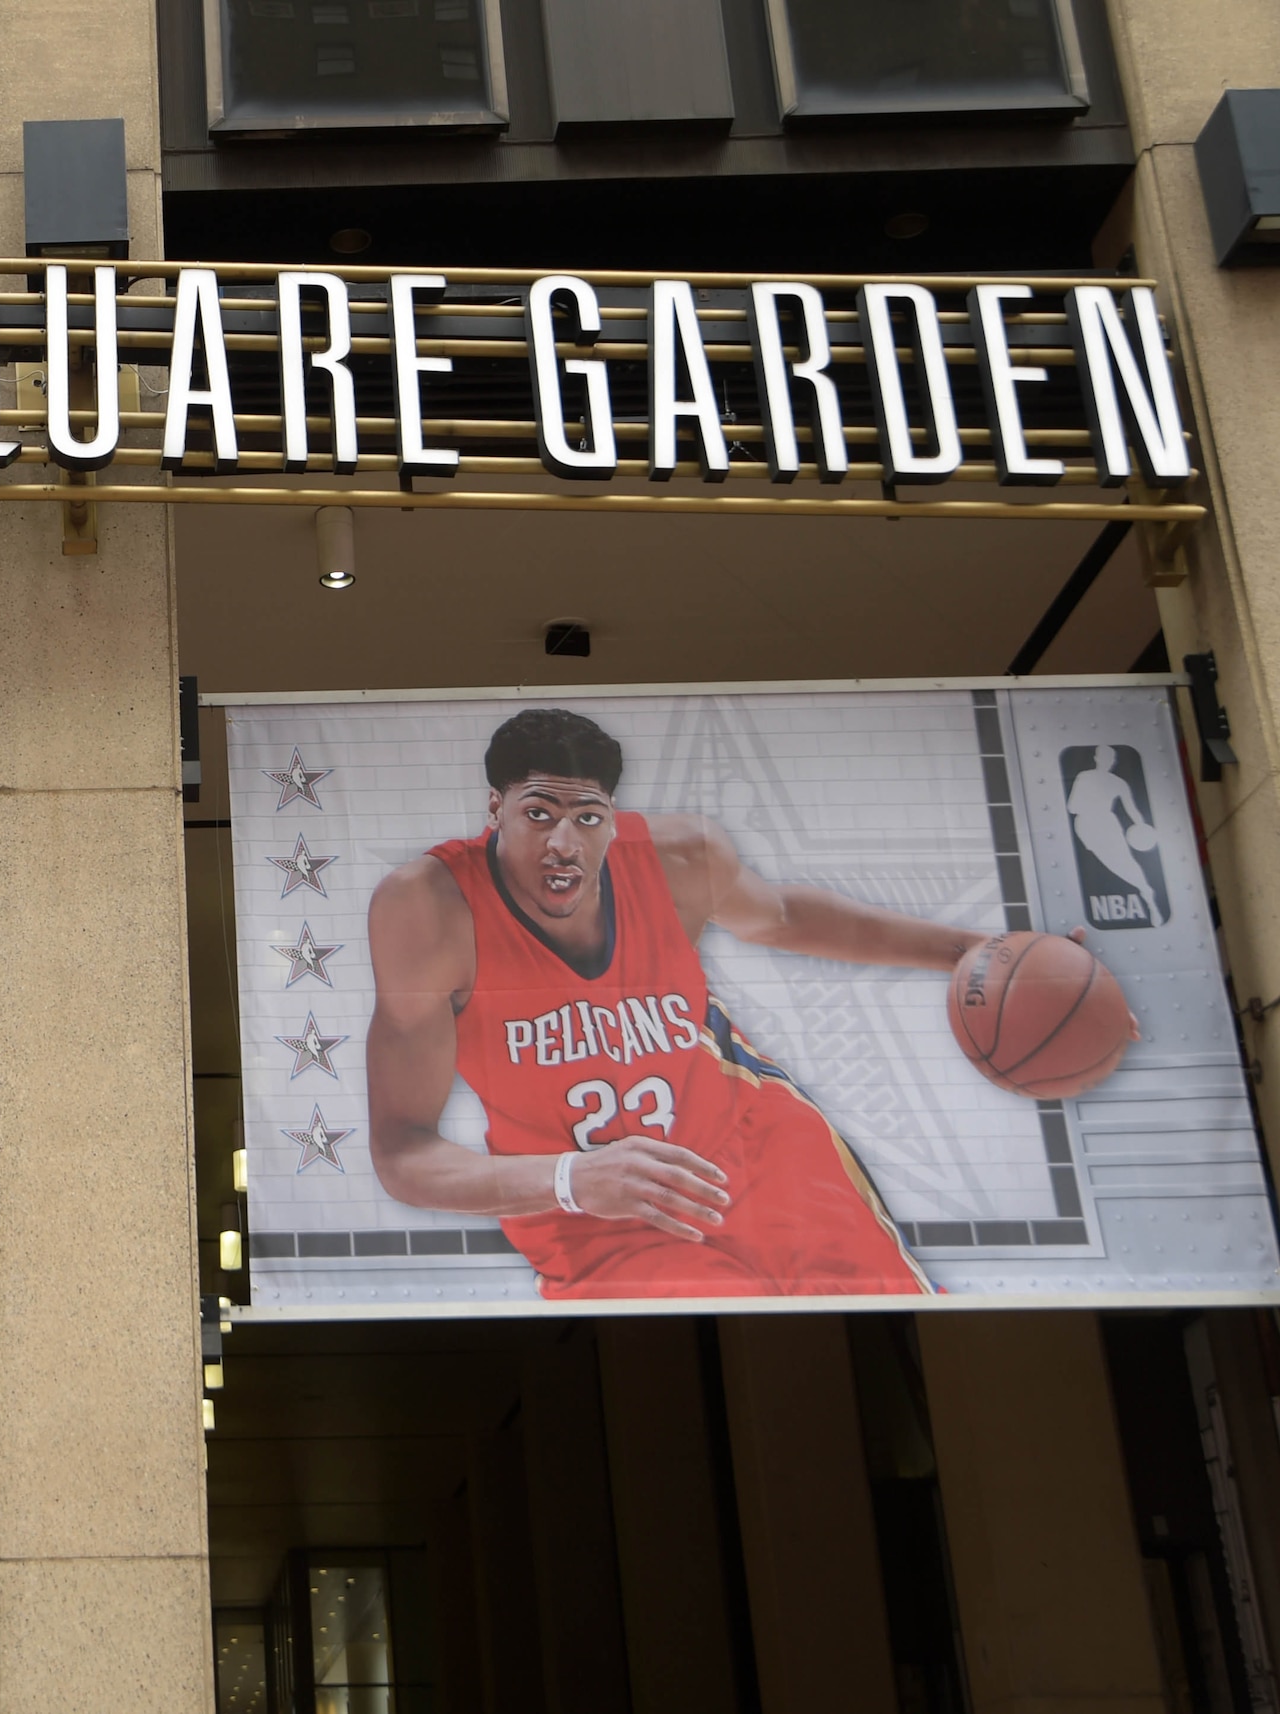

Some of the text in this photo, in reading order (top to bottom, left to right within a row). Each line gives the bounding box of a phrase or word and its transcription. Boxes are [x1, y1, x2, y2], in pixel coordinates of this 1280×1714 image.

[526, 274, 1192, 478] GARDEN
[1089, 893, 1146, 921] NBA
[504, 993, 699, 1066] PELICANS
[566, 1075, 676, 1152] 23
